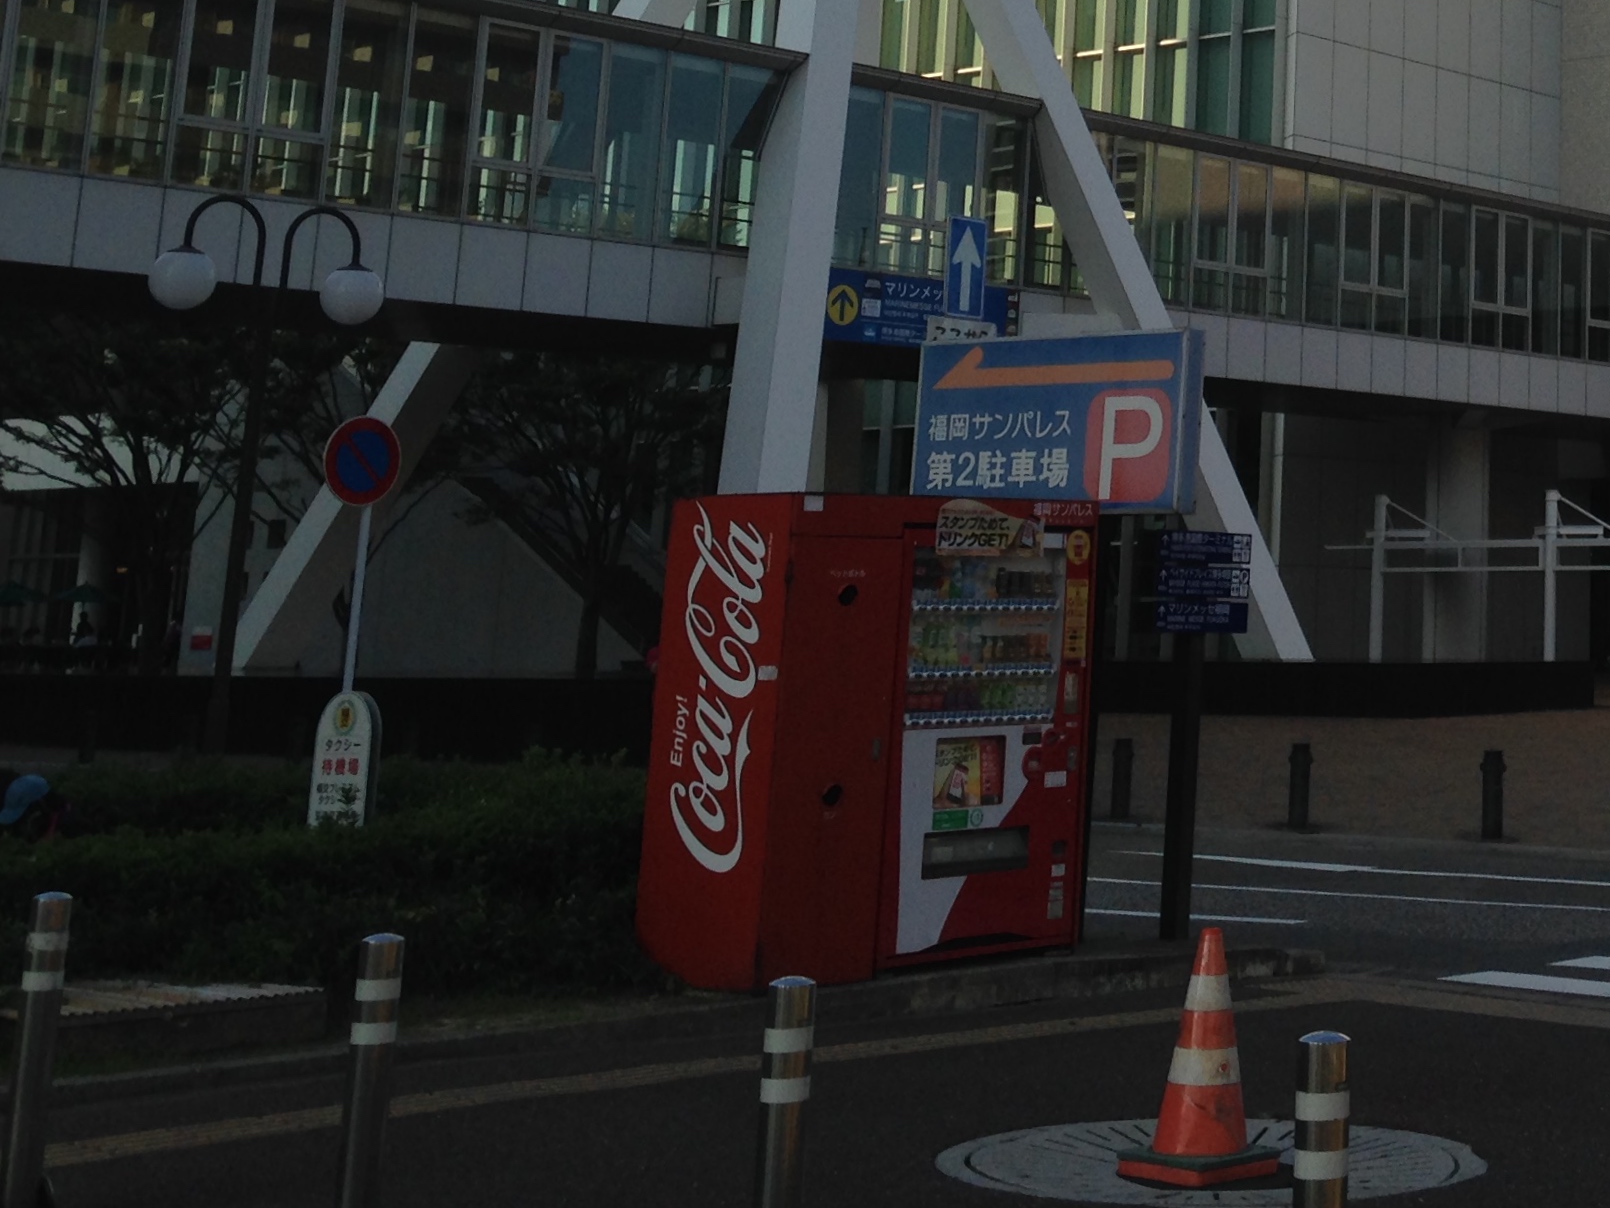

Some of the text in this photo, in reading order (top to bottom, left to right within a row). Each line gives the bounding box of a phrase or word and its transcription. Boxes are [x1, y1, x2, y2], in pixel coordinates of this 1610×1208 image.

[929, 409, 1071, 443] 福岡サンパレス
[1099, 396, 1163, 500] P
[927, 448, 1070, 491] 第2駐車場
[670, 501, 766, 873] Coca-Cola
[670, 695, 687, 767] Enjoy!
